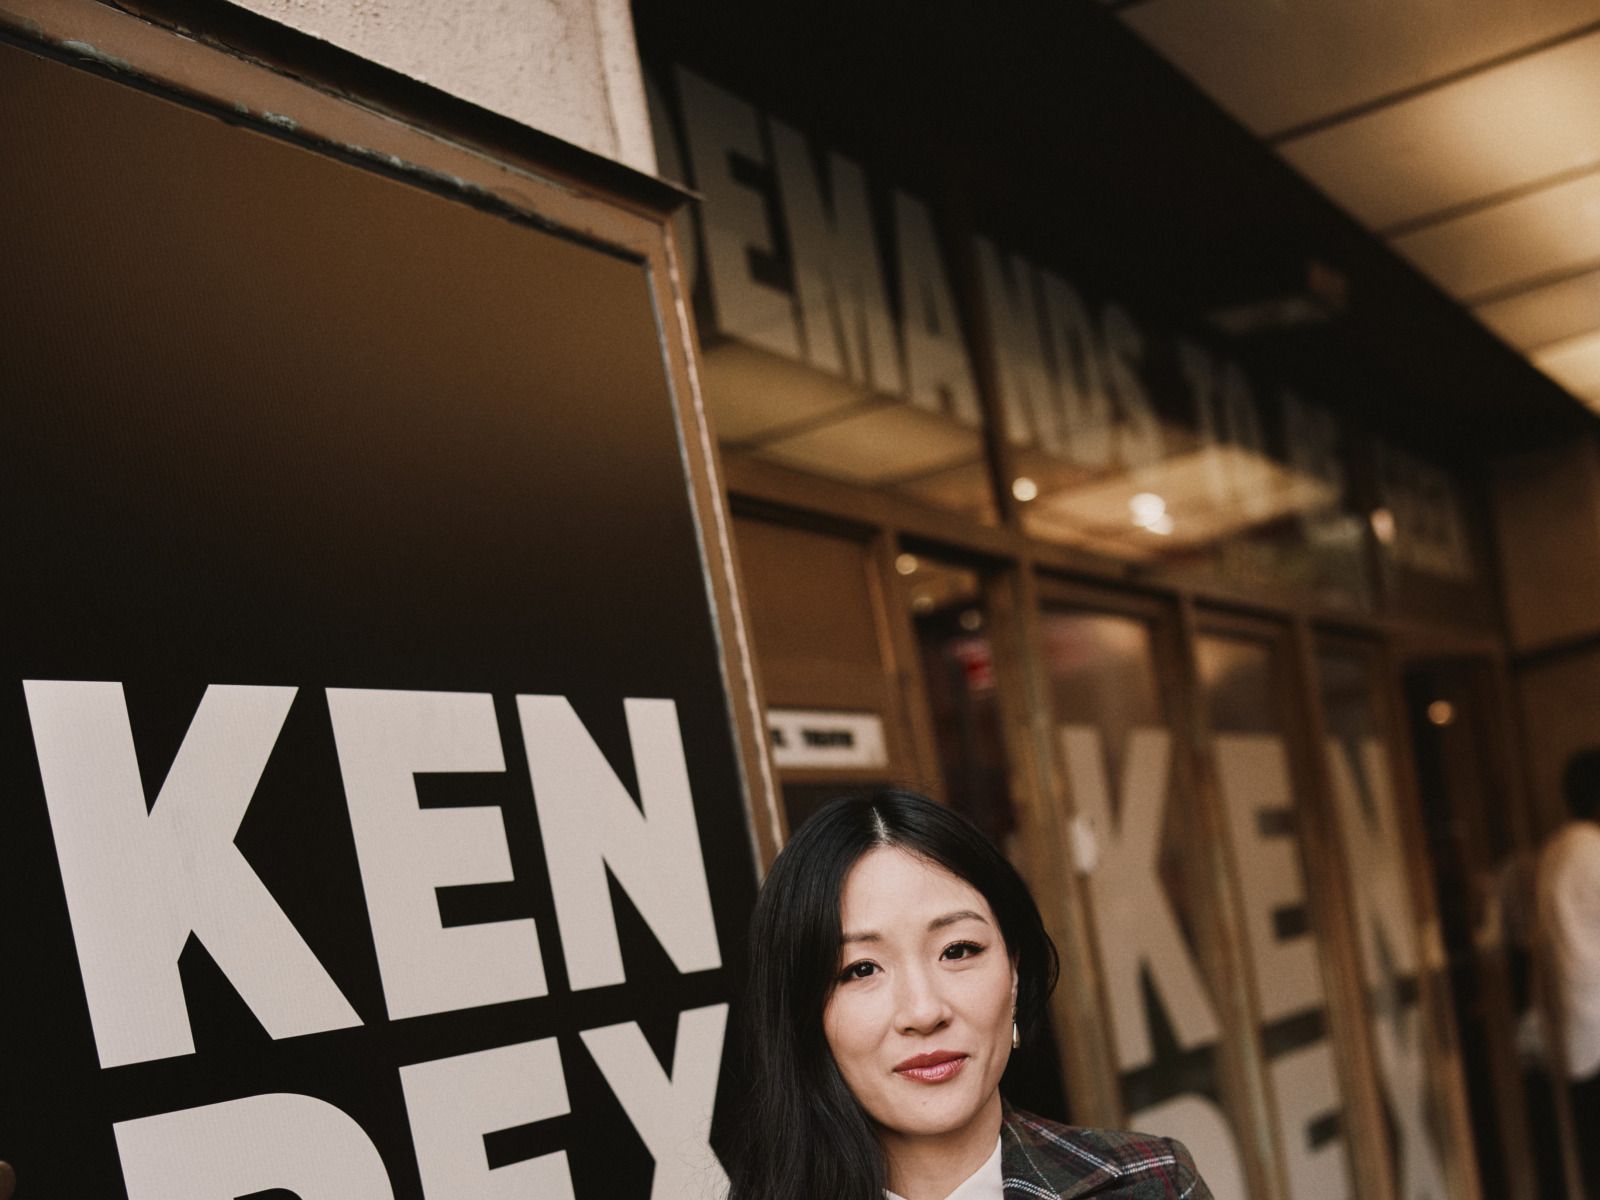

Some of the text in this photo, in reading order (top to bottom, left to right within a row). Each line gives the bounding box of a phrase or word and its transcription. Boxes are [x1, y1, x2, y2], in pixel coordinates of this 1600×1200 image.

[642, 60, 1166, 470] EMANDS
[22, 679, 723, 1070] KEN
[1060, 722, 1424, 1072] KEN
